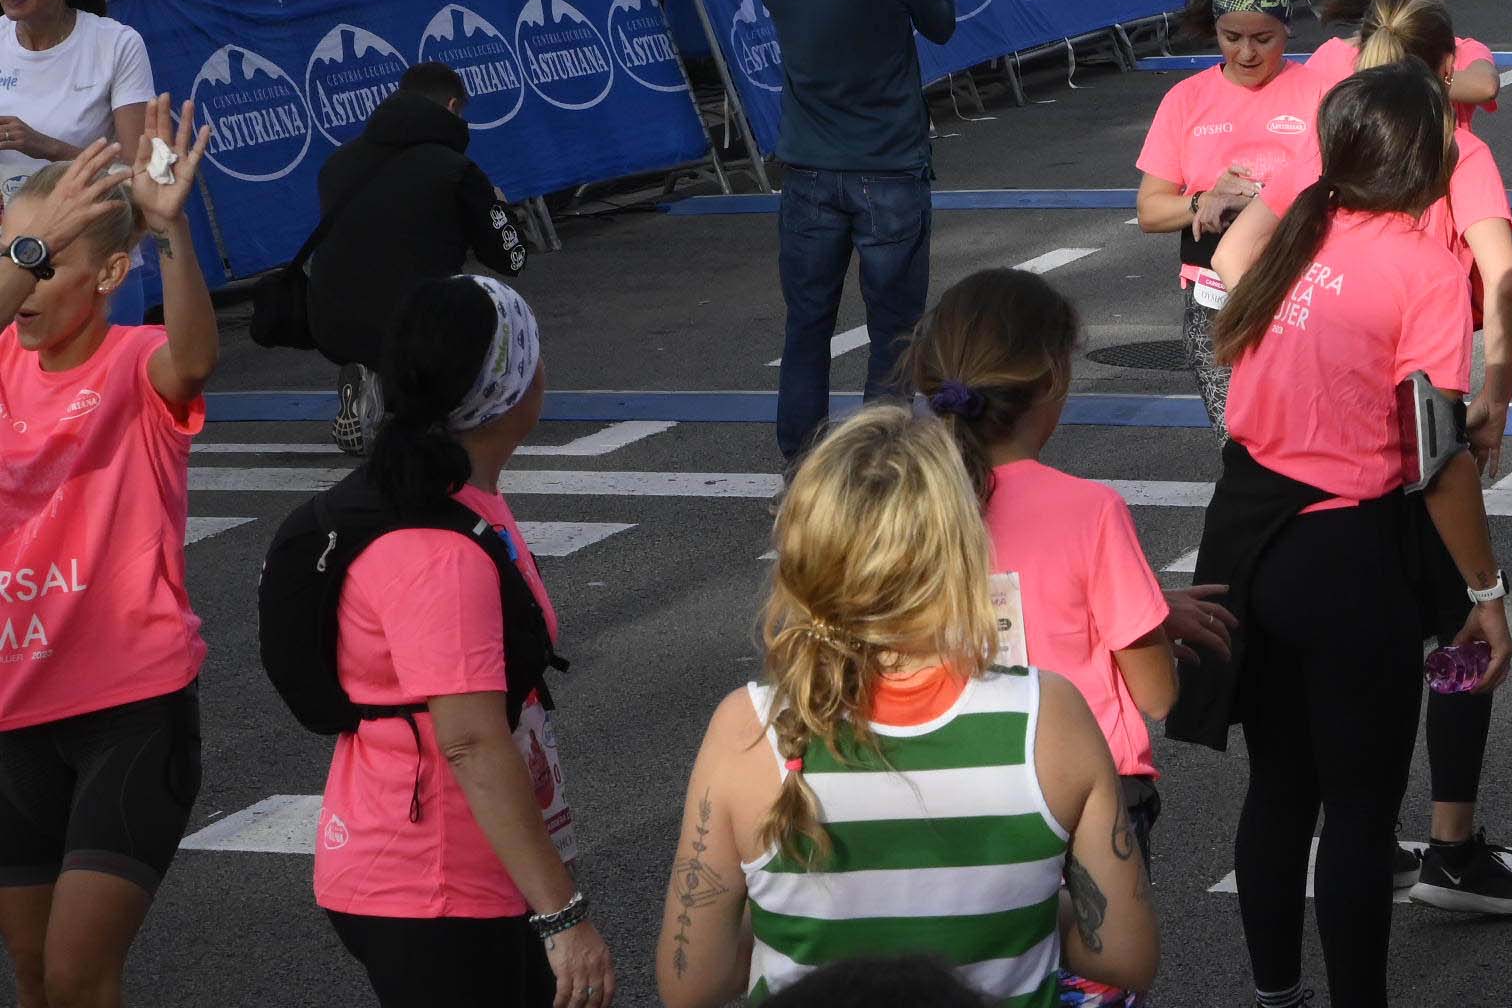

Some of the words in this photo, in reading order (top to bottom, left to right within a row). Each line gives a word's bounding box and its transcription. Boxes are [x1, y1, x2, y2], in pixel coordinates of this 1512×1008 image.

[326, 70, 362, 87] CENTRAL
[453, 59, 520, 97] TURIANA
[524, 40, 609, 84] ASTURIANA
[213, 92, 251, 110] CENTRAL
[316, 79, 400, 129] ASTURIAN
[202, 101, 305, 154] ASTURIANA
[1193, 122, 1232, 137] OYSHO
[1274, 300, 1310, 331] UJER
[0, 558, 87, 604] RSAL
